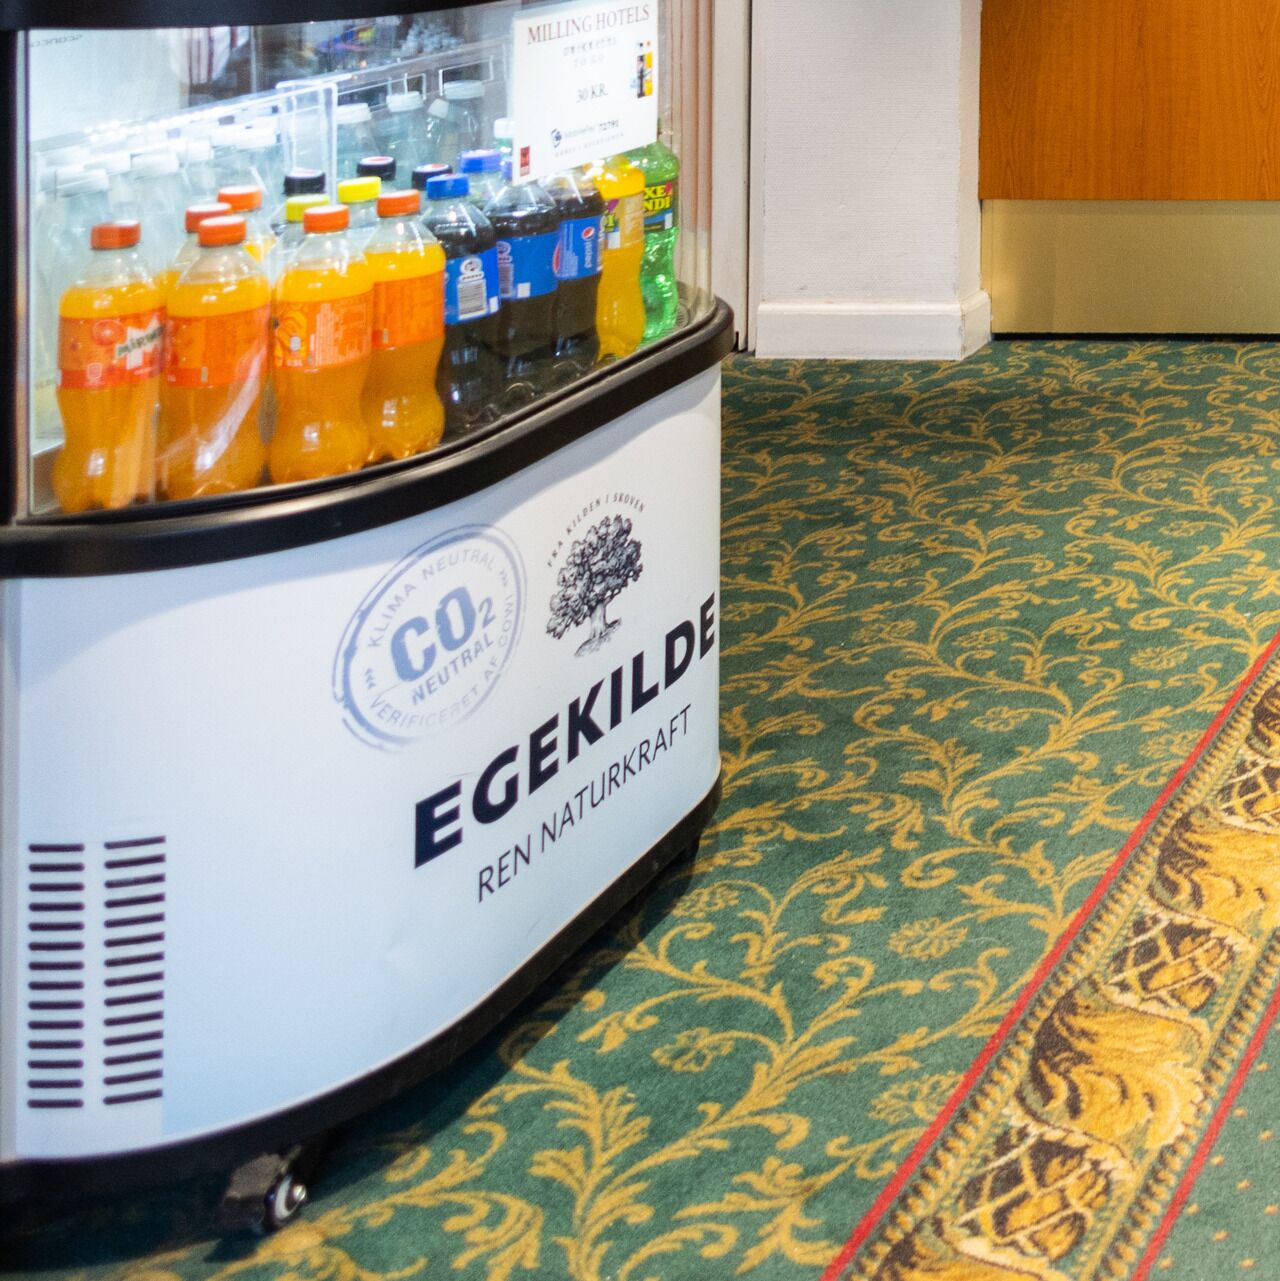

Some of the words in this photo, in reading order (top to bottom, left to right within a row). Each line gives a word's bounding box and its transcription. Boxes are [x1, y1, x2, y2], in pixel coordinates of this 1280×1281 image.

[527, 15, 592, 46] MILLING
[594, 3, 651, 31] HOTELS
[584, 238, 593, 269] pepsi
[368, 582, 417, 649] KLIMA
[421, 548, 497, 581] NEUTRAL
[411, 633, 494, 706] NEUTRAL
[414, 591, 716, 870] EGEKILDE
[477, 833, 532, 904] REN
[540, 702, 692, 854] NATURKRAFT
